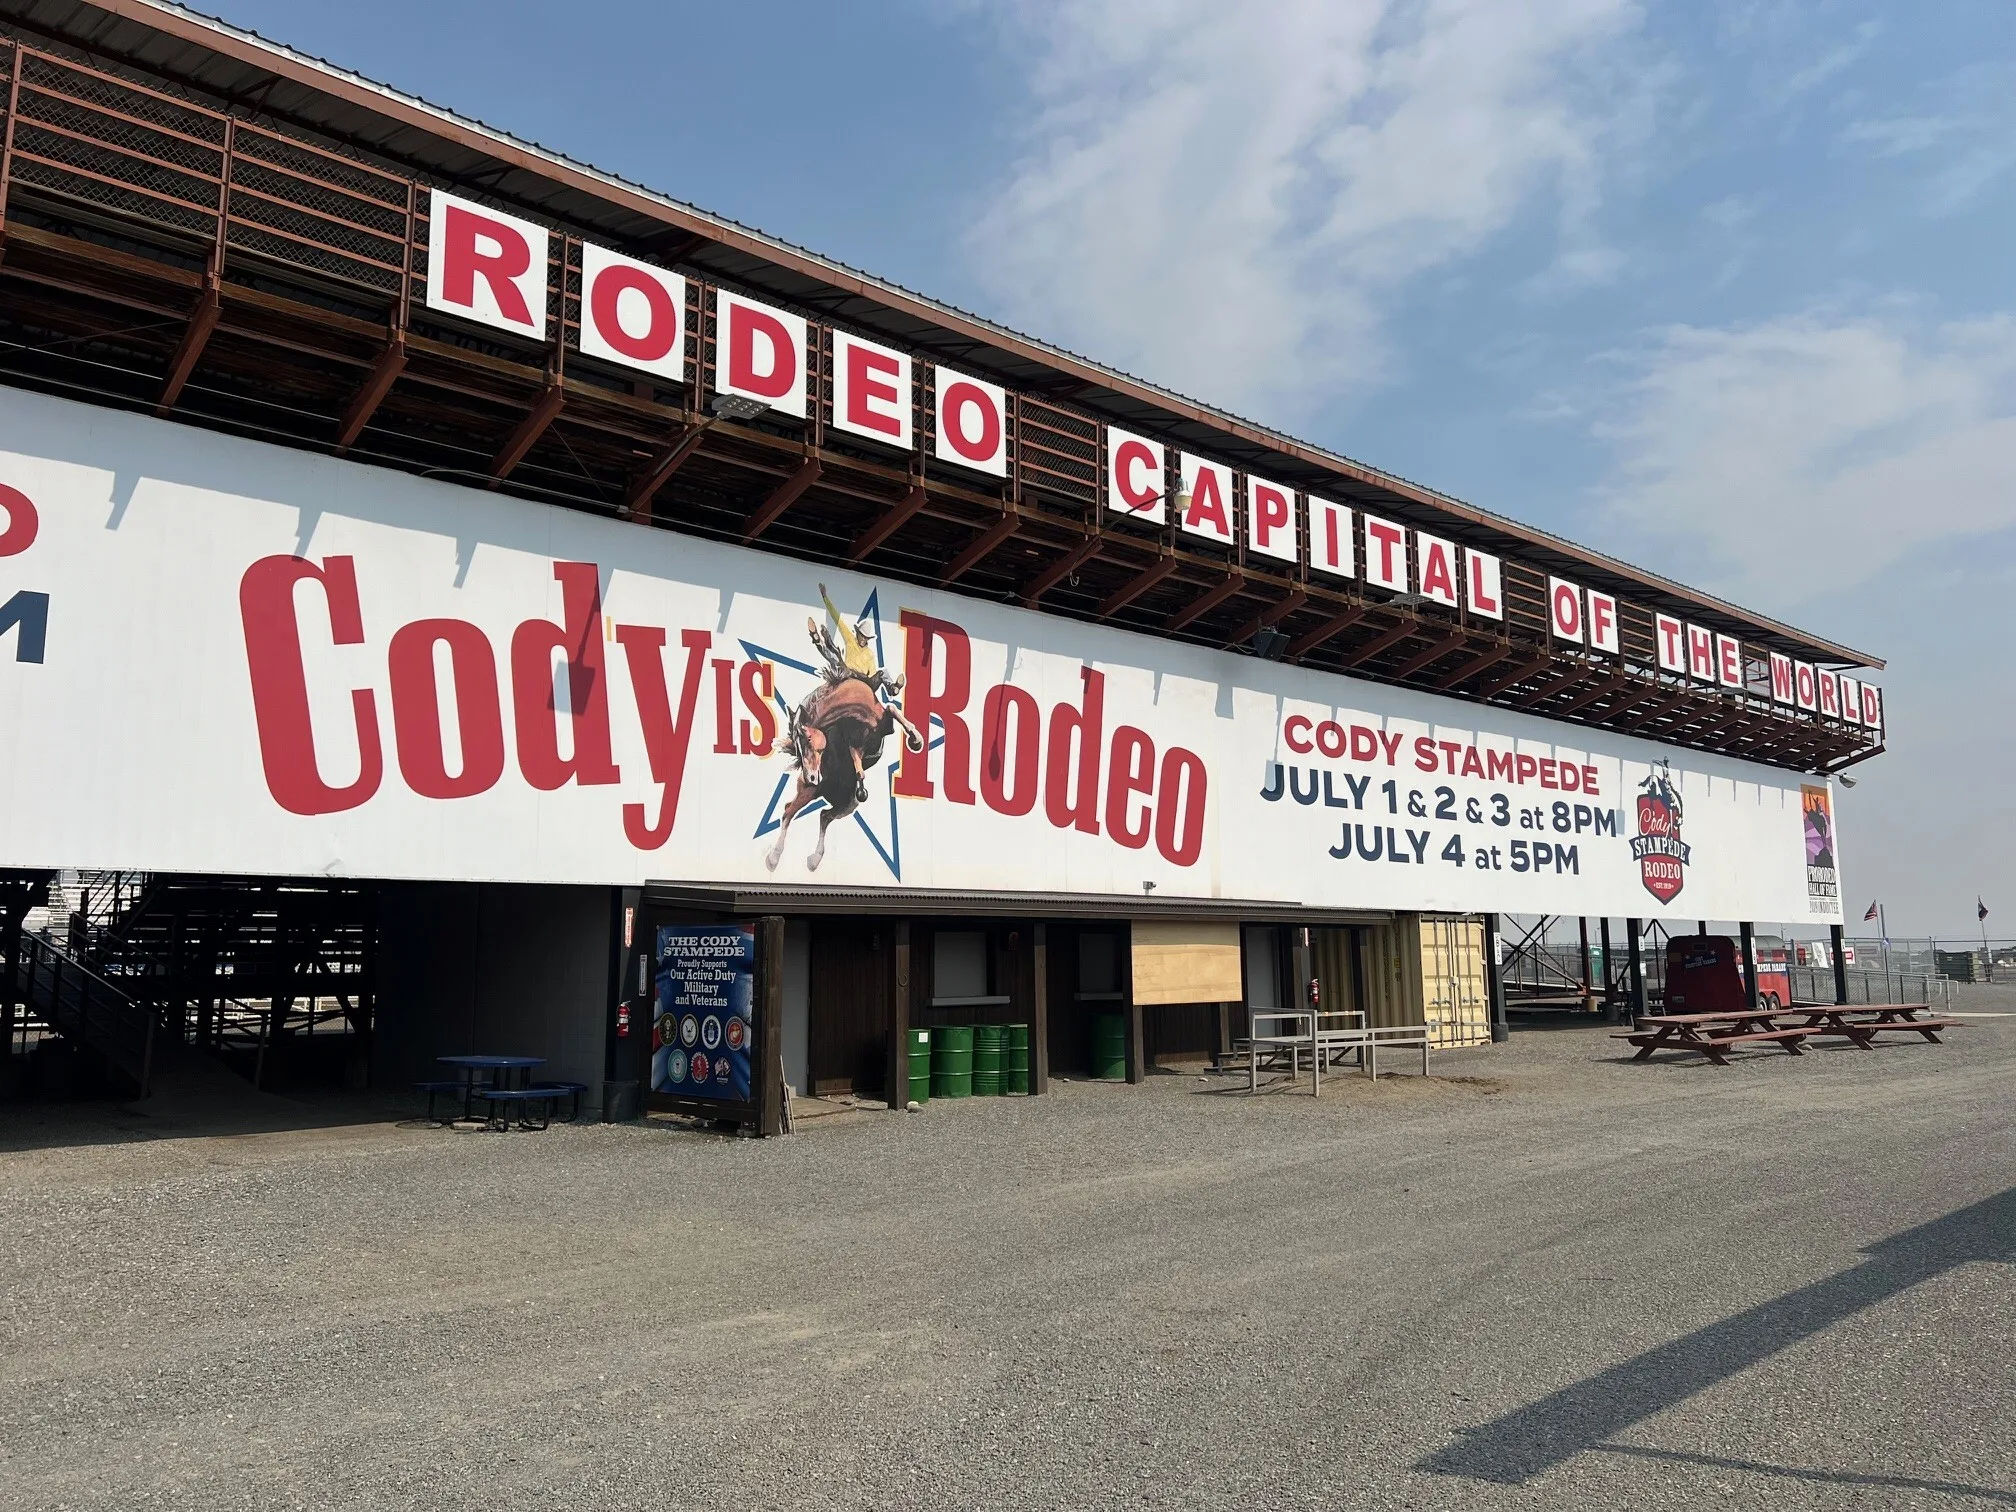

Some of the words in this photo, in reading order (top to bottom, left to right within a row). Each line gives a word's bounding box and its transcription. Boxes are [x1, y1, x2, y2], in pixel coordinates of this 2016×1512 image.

[442, 206, 1000, 462] RODEO
[1115, 440, 1497, 613] CAPITAL
[1554, 585, 1613, 645] OF
[1658, 613, 1740, 684] THE
[1771, 656, 1878, 725] WORLD
[239, 554, 712, 850] Cody
[711, 659, 776, 756] IS
[897, 610, 1208, 867] Rodeo
[1284, 714, 1403, 766] CODY
[1414, 736, 1600, 796] STAMPEDE
[1260, 764, 1371, 810] JULY
[1382, 779, 1398, 814] 1
[1407, 789, 1427, 817] &
[1435, 786, 1457, 821] 2
[1465, 799, 1483, 824] &
[1490, 793, 1511, 827] 3
[1520, 807, 1544, 831] at
[1552, 801, 1617, 839] 8PM
[1639, 808, 1671, 839] Cody
[1328, 823, 1430, 865] JULY
[1441, 834, 1466, 868] 4
[1475, 846, 1501, 871] at
[1510, 840, 1579, 875] 5PM
[1634, 836, 1686, 860] STAMPEDE
[1644, 861, 1681, 880] RODEO
[1809, 882, 1820, 895] HALL
[668, 936, 698, 946] THE
[700, 936, 741, 947] CODY
[663, 946, 745, 957] STAMPEDE
[677, 959, 701, 970] Proudly
[701, 960, 728, 970] Supports
[670, 969, 685, 980] Our
[686, 969, 713, 981] Active
[714, 969, 737, 983] Duty
[684, 981, 719, 996] Military
[675, 996, 690, 1005] and
[690, 994, 728, 1007] Veterans
